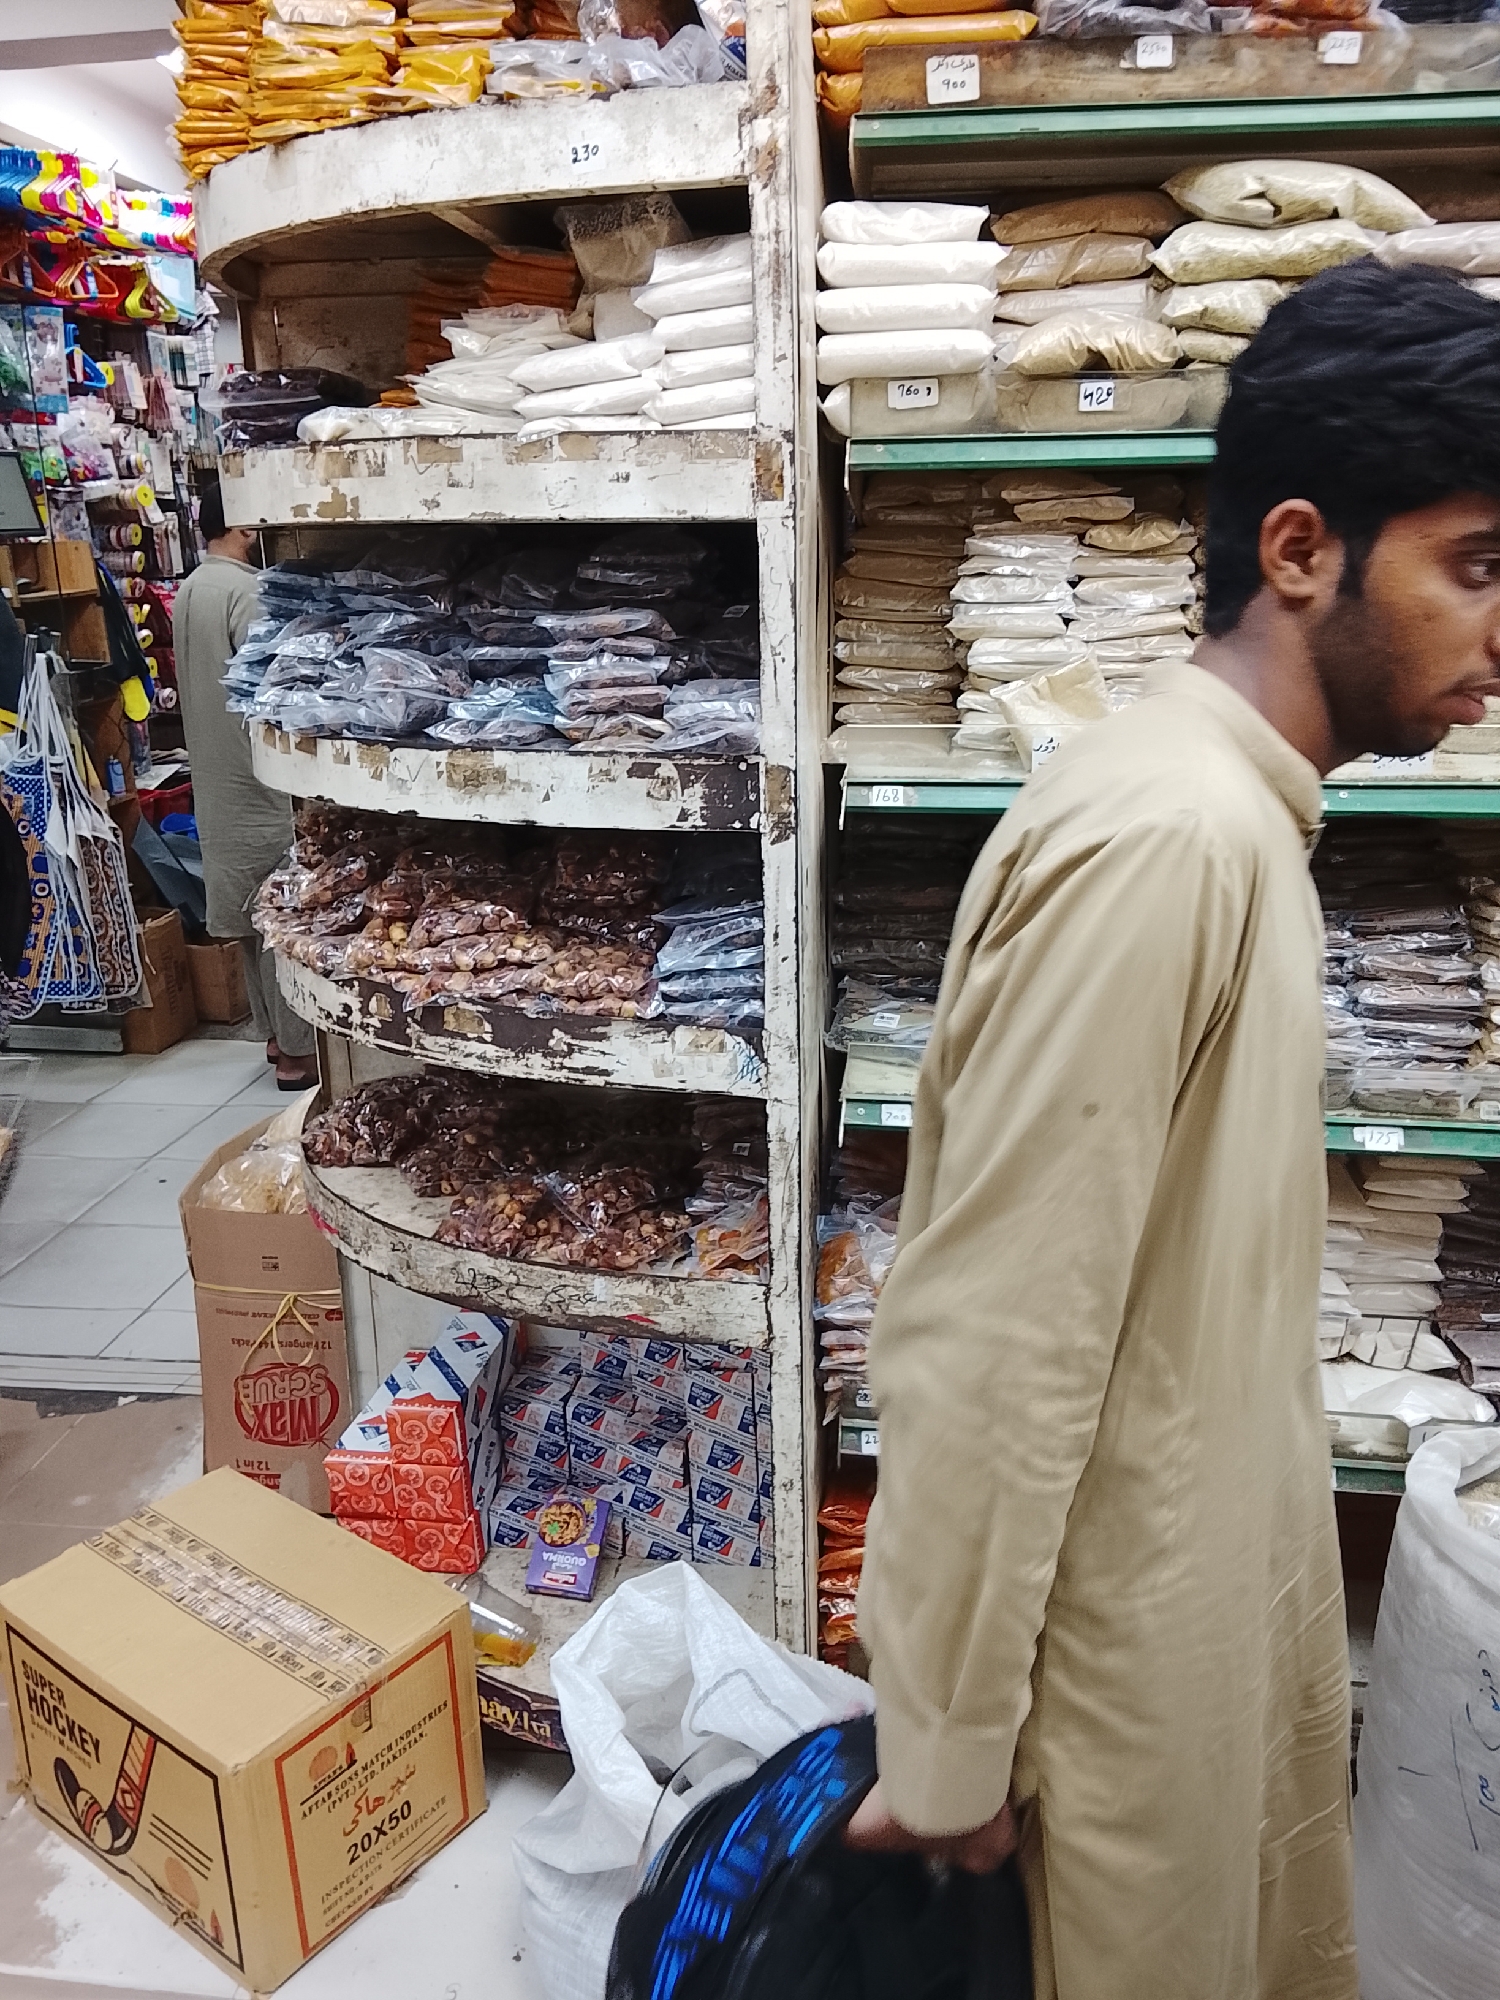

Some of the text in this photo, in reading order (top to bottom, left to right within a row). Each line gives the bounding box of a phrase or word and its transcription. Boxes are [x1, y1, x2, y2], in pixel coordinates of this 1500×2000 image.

[941, 78, 966, 90] 900
[571, 143, 599, 165] 230
[875, 788, 900, 803] 168
[321, 1340, 331, 1349] 12
[238, 1368, 329, 1404] SCRUB
[251, 1395, 319, 1444] Max
[243, 1459, 255, 1470] in
[257, 1461, 271, 1472] 12
[21, 1659, 67, 1709] SUPER
[25, 1682, 101, 1764] HOCKEY
[301, 1699, 448, 1821] AFTAB SONS MATCH INDUSTRIES
[321, 1795, 448, 1905] INSPECTION CERTIFICATE
[346, 1799, 412, 1866] 20X50
